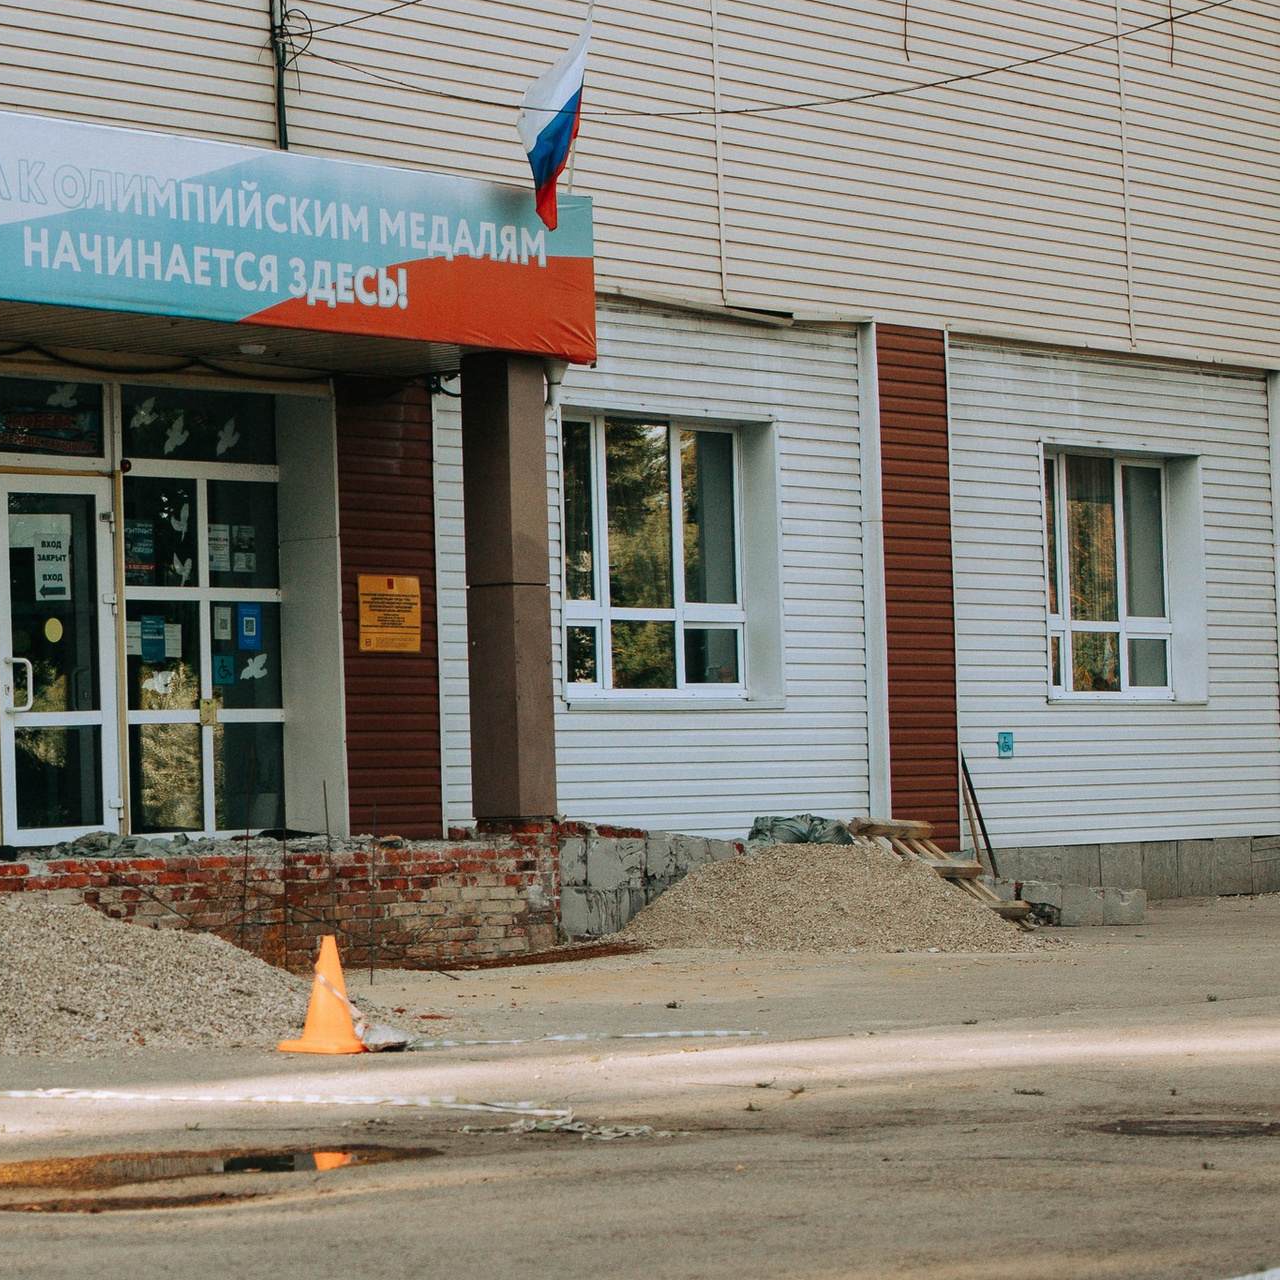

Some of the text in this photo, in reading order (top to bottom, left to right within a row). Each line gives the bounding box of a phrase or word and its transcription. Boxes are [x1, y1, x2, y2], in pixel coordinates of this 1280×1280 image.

[18, 159, 48, 206] К
[53, 164, 370, 244] ОЛИМПИЙСКИМ
[379, 208, 547, 268] МЕДАЛЯМ
[23, 226, 409, 310] НАЧИНАЕТСЯ ЗДЕСЬ!
[41, 541, 62, 549] ВХОД
[42, 574, 63, 582] ВХОД
